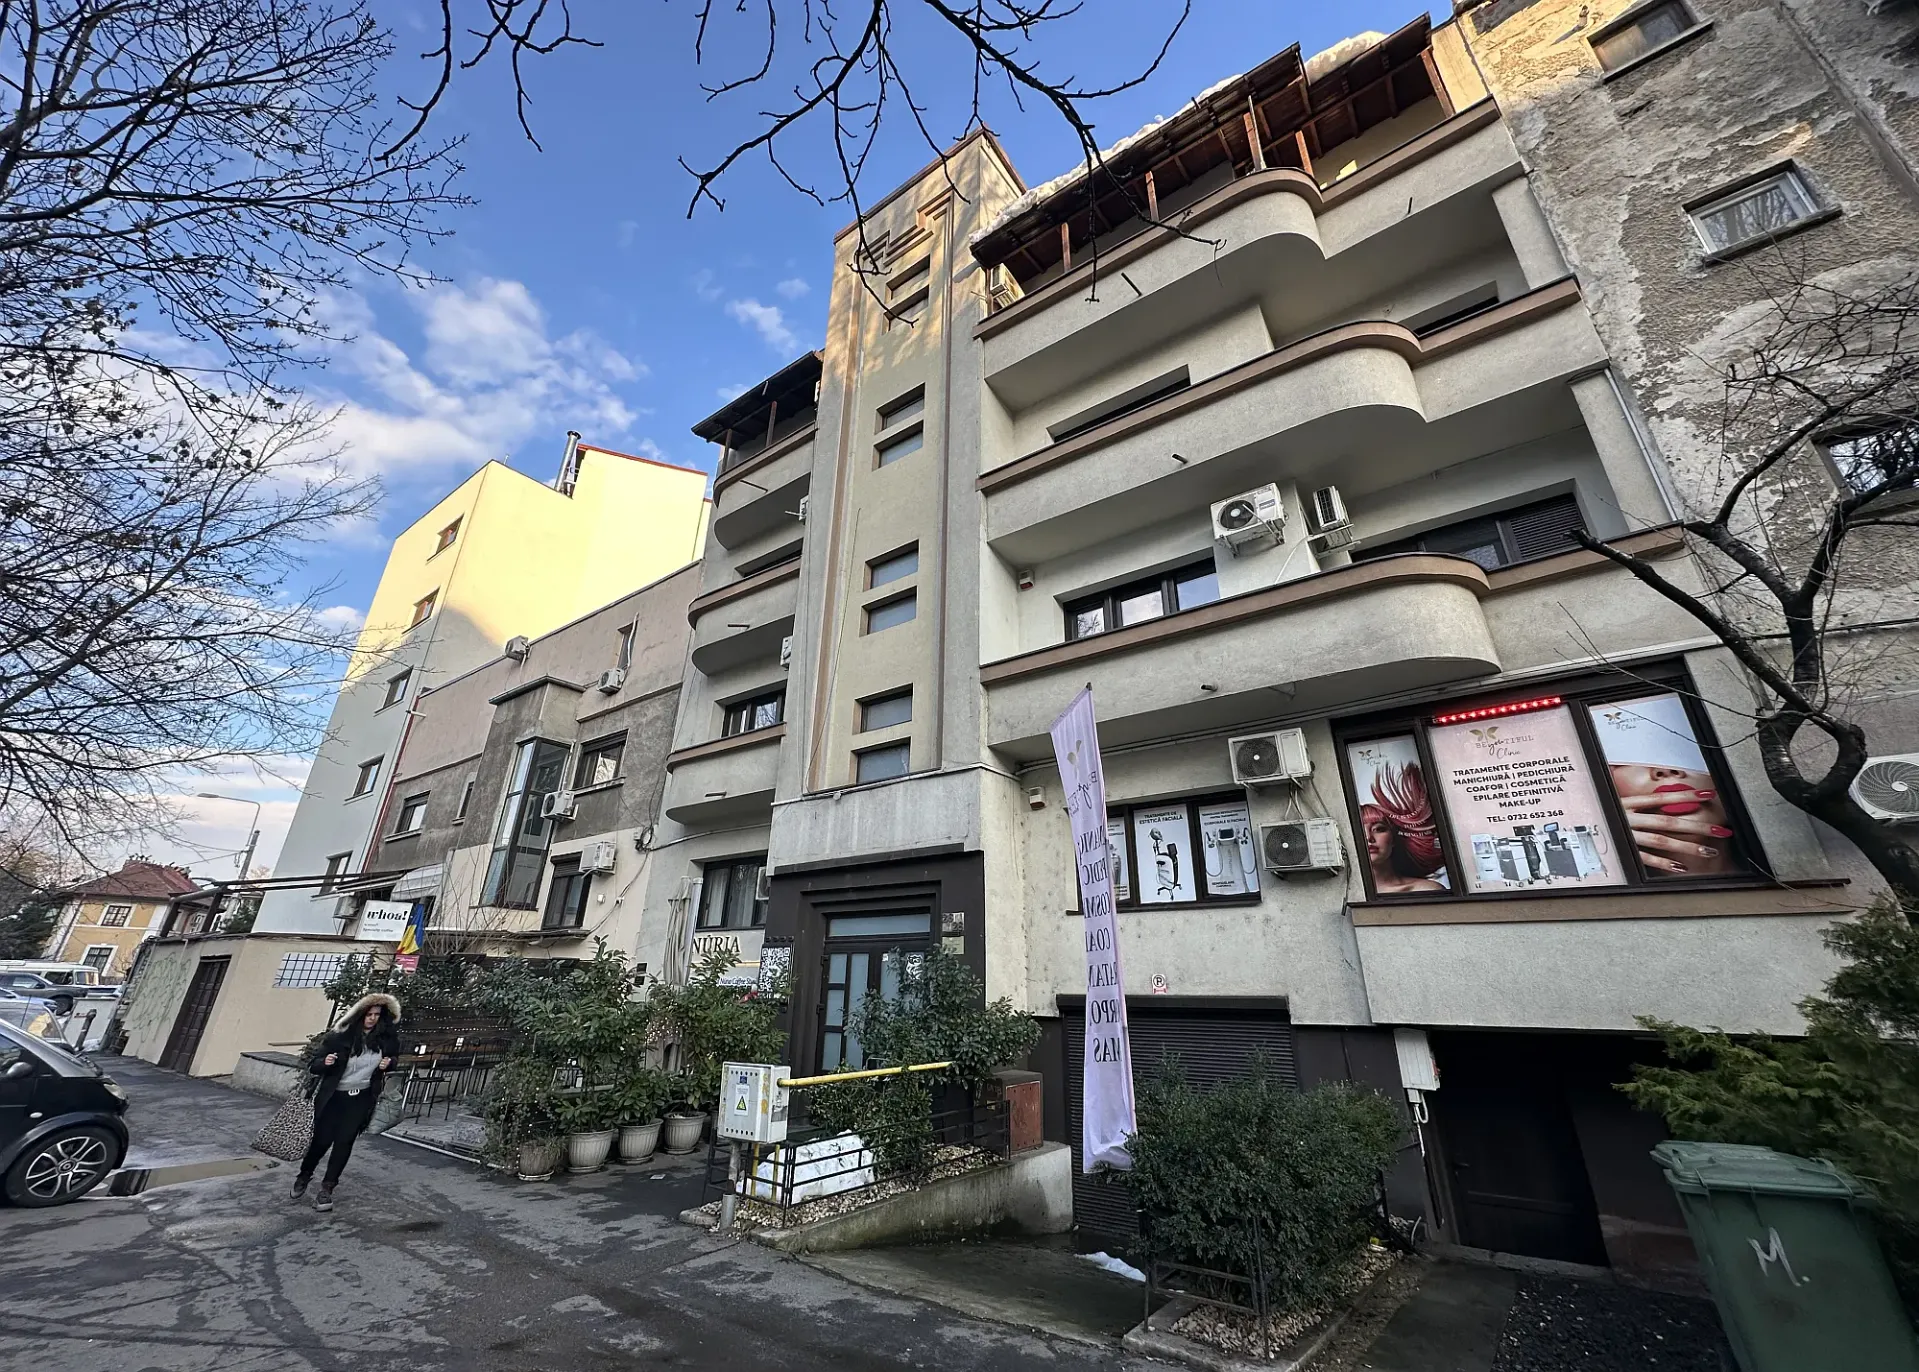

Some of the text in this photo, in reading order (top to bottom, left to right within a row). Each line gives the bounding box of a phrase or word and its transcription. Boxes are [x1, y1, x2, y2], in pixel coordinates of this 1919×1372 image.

[1453, 756, 1570, 777] TRATAMENTE CORPORALE
[1453, 772, 1510, 786] MANICHIURĂ
[1517, 764, 1575, 778] PEDICHIURĂ
[1466, 783, 1503, 793] COAFOR
[1510, 775, 1567, 788] COSMETICĂ
[1473, 785, 1564, 802] EPILARE DEFINITIVĂ
[1499, 798, 1542, 808] MAKE-UP
[1507, 813, 1528, 821] 0732
[1529, 811, 1546, 819] 652
[1547, 809, 1564, 818] 368
[367, 909, 408, 920] whoa!
